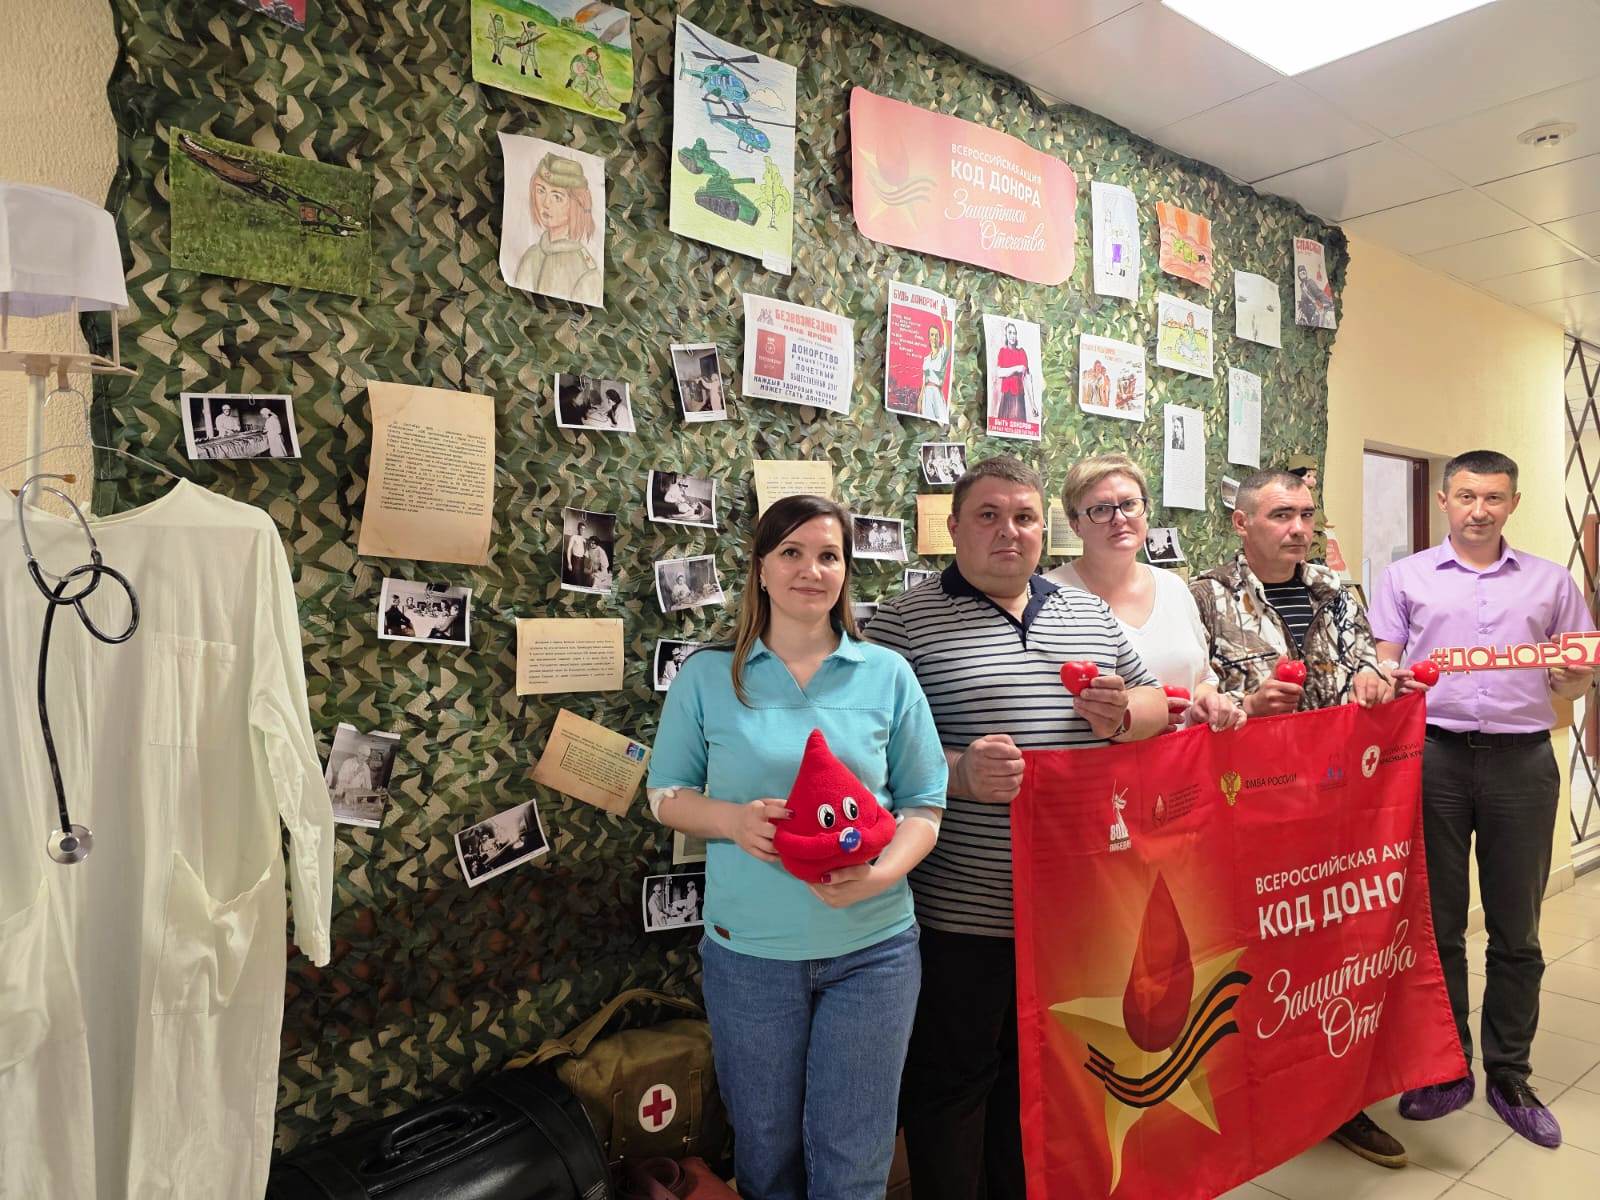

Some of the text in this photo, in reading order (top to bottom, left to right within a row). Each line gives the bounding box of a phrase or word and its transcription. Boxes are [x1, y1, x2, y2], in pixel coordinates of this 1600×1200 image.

[951, 159, 1042, 209] КОД ДОНОРА
[979, 220, 1046, 252] Отечества
[893, 288, 909, 302] БУДЬ
[791, 343, 839, 364] ДОНОРСТВО
[795, 363, 834, 380] ПОЧЕТНЫЙ
[753, 376, 781, 387] КАЖДЫЙ
[760, 384, 782, 394] МОЖЕТ
[785, 388, 803, 399] СТАТЬ
[1267, 773, 1297, 786] РОССИИ
[1255, 847, 1377, 895] ВСЕРОССИЙСКАЯ
[1258, 867, 1407, 940] КОД ДОНО
